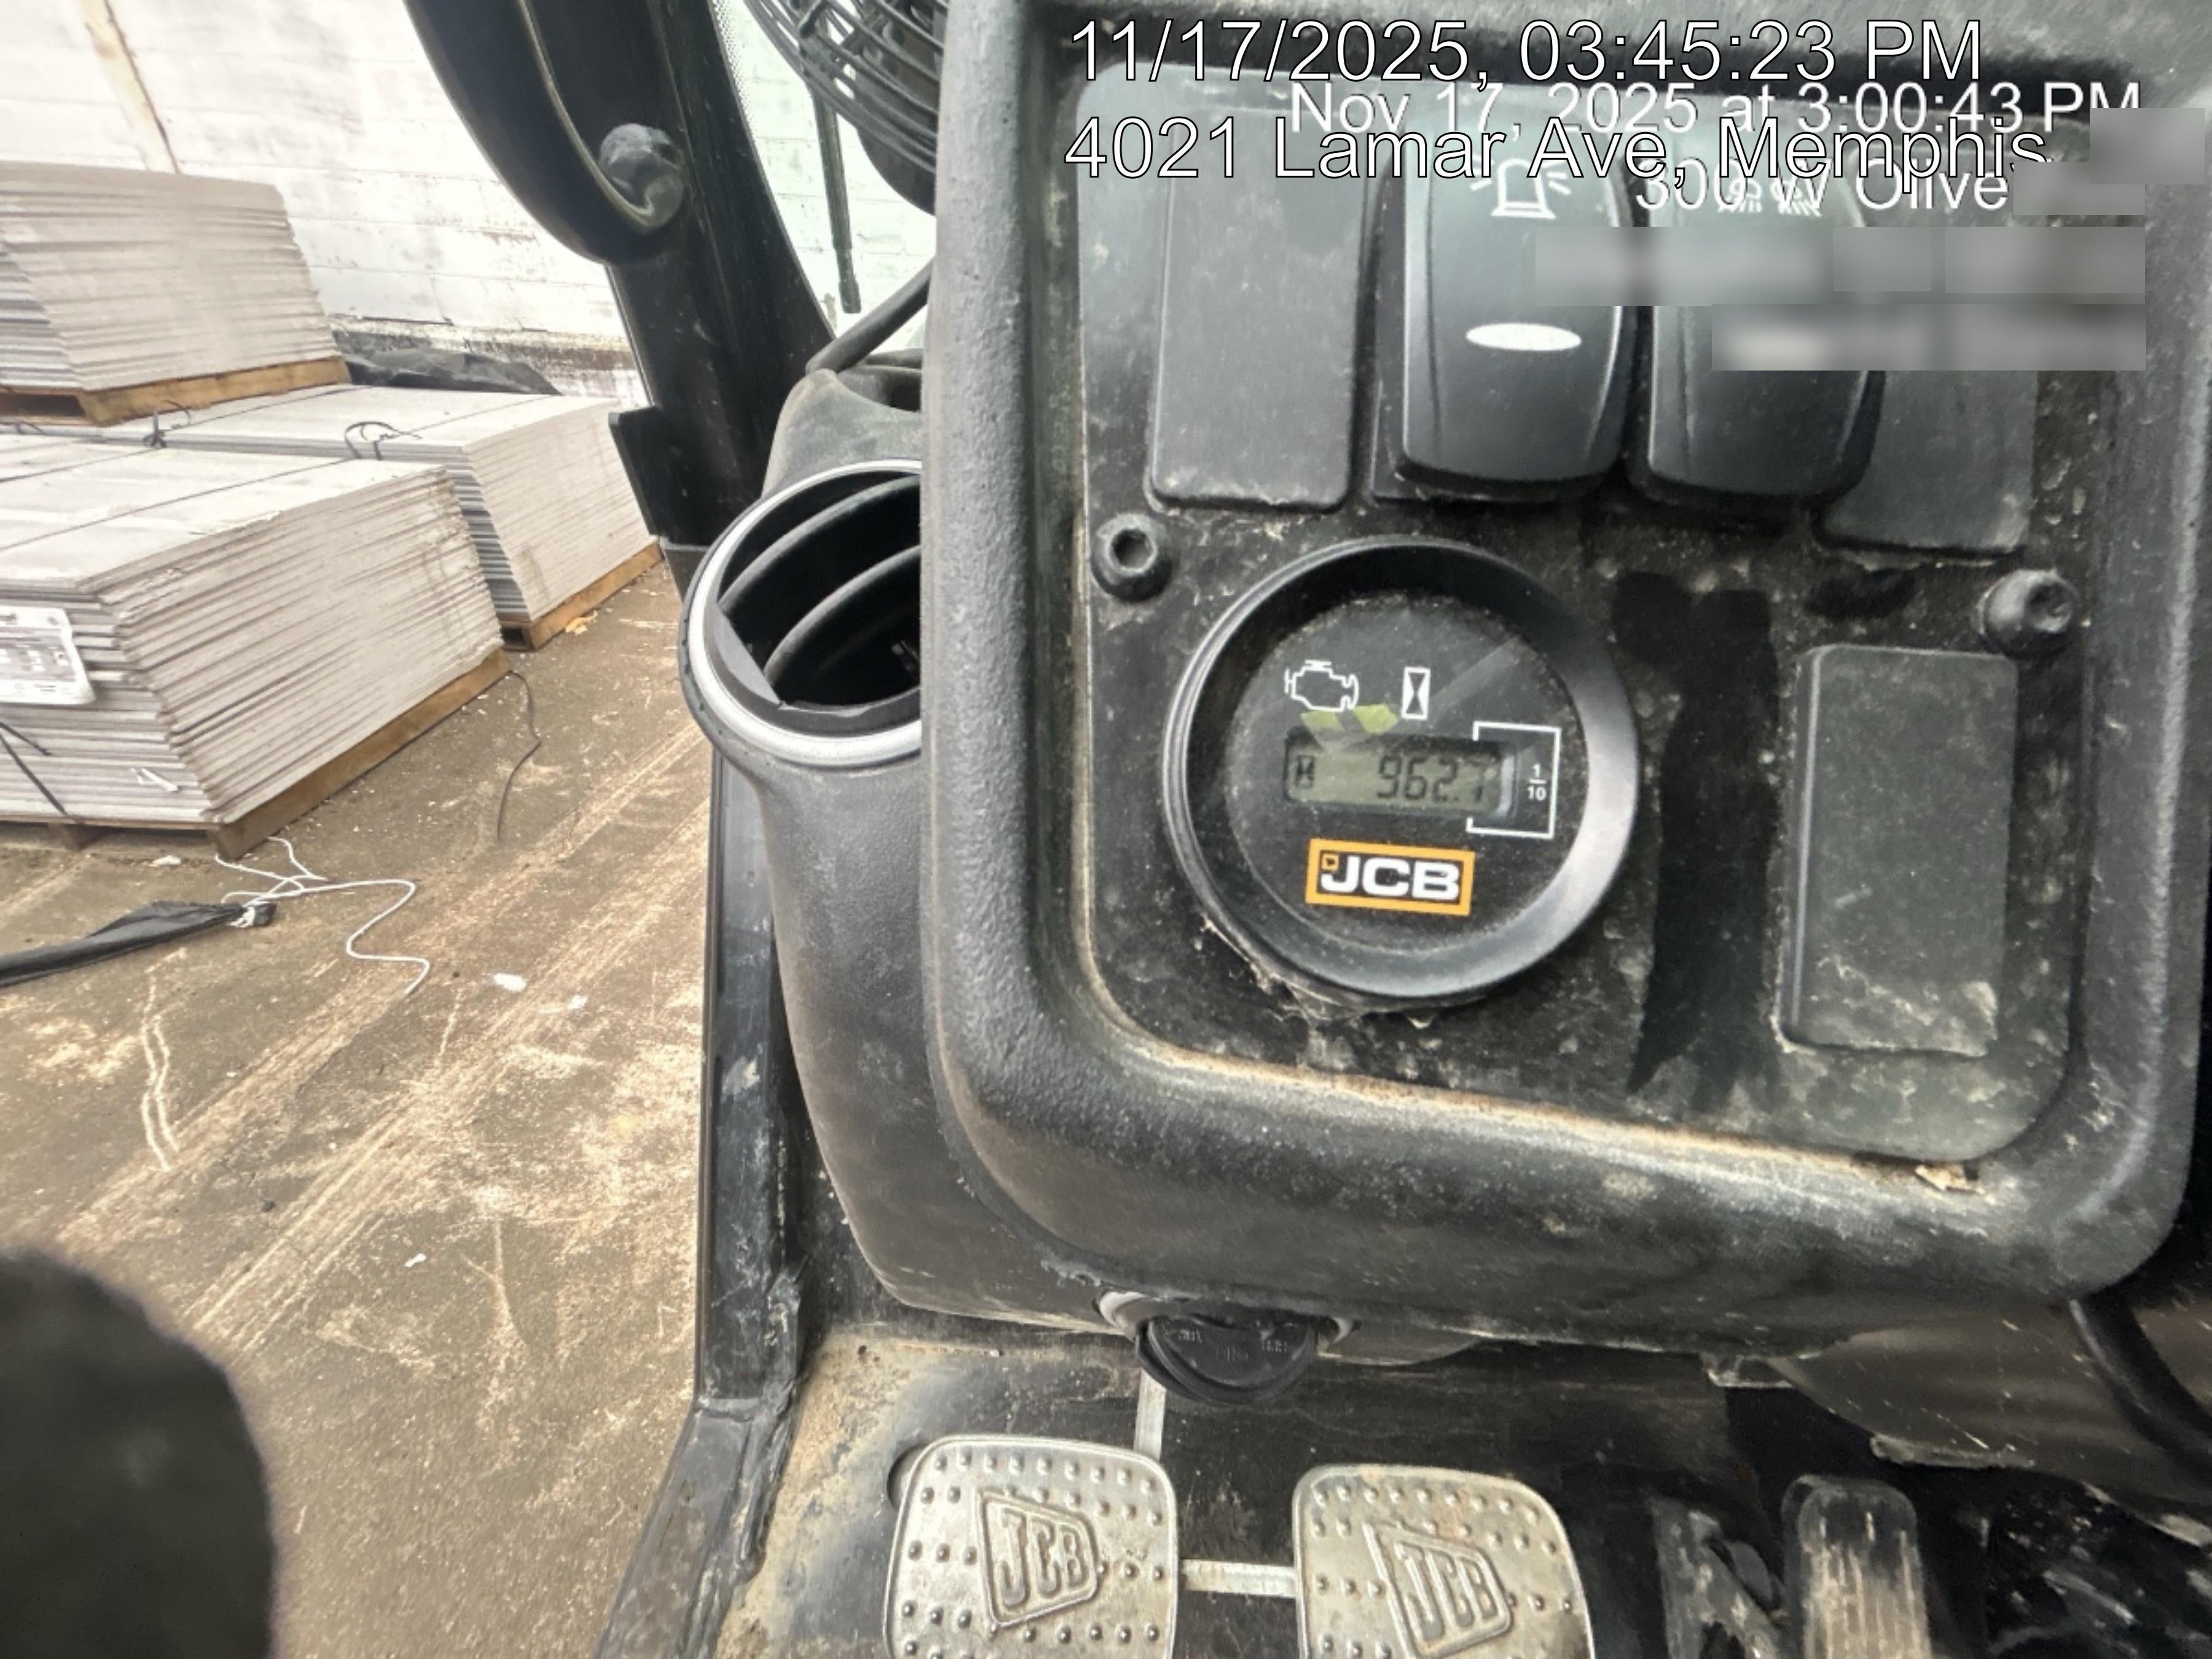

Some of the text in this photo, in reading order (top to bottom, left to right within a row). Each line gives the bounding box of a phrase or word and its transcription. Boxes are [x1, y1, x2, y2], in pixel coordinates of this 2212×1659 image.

[1527, 785, 1547, 801] 10
[1320, 853, 1460, 901] JCB
[999, 1507, 1090, 1607] JCB
[1394, 1541, 1498, 1642] JCB
